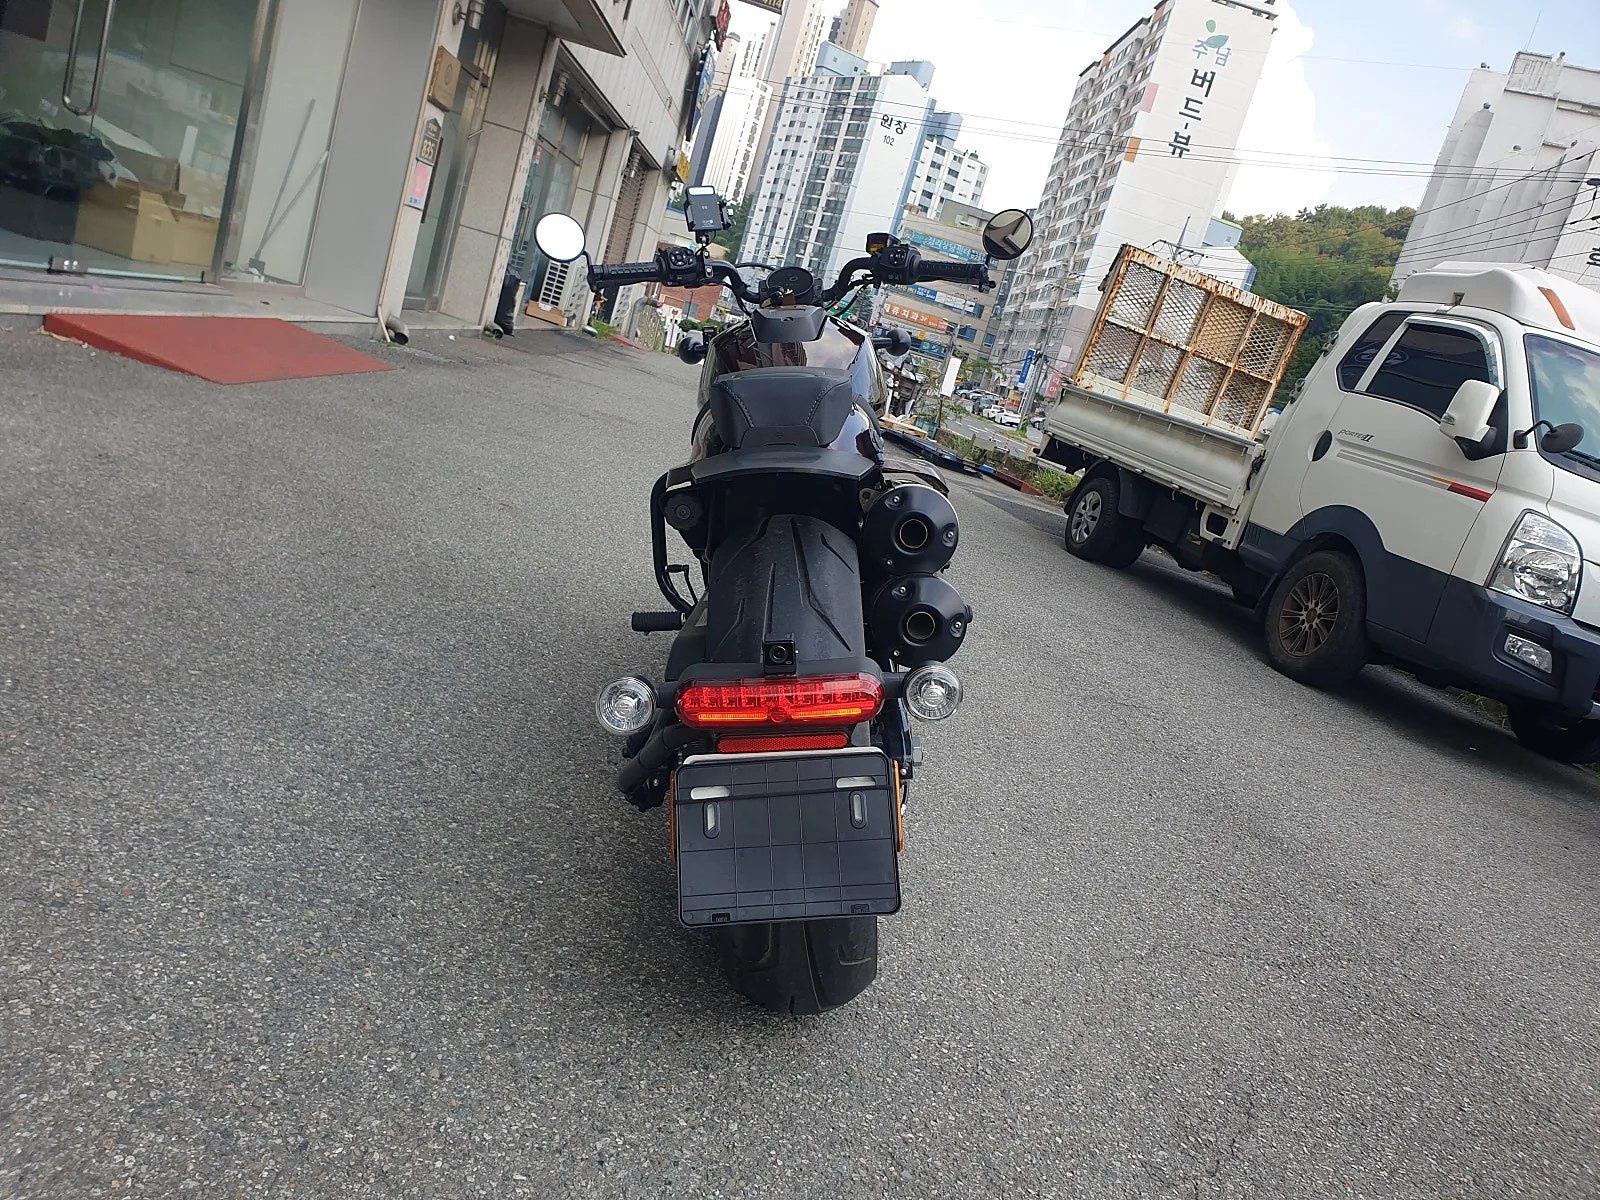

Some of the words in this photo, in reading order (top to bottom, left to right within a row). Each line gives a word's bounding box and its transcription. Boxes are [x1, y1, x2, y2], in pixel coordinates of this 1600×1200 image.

[1192, 39, 1232, 67] 주남
[880, 114, 907, 135] 원창
[421, 139, 435, 160] 835
[883, 135, 895, 147] 102
